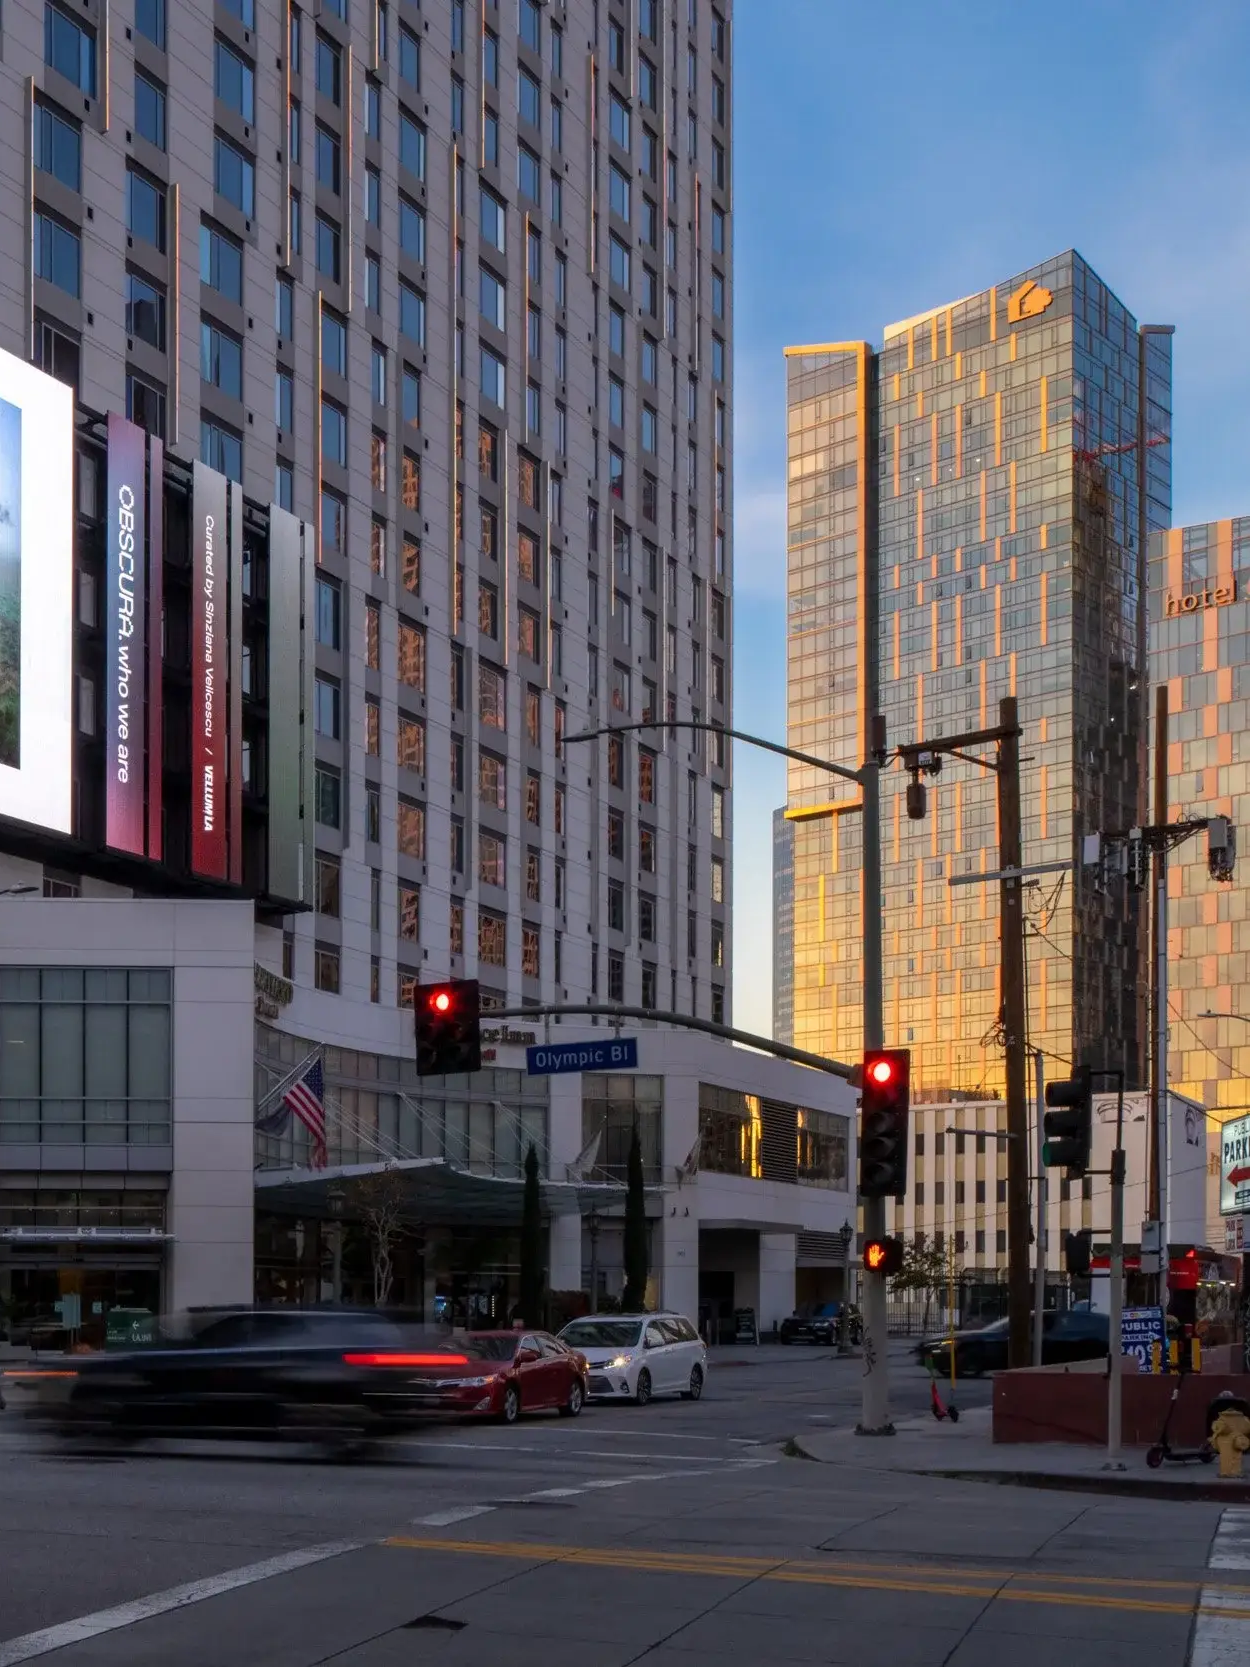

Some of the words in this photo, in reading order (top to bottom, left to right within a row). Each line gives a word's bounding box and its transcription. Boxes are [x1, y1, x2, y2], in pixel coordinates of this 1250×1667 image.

[205, 514, 215, 577] Curated
[203, 578, 215, 599] by
[1165, 573, 1236, 619] hotel
[205, 600, 215, 663] Sinziana
[118, 645, 132, 698] who
[117, 704, 129, 740] we
[205, 667, 214, 738] Velicescu
[117, 744, 129, 784] are
[536, 1051, 604, 1070] Olympic
